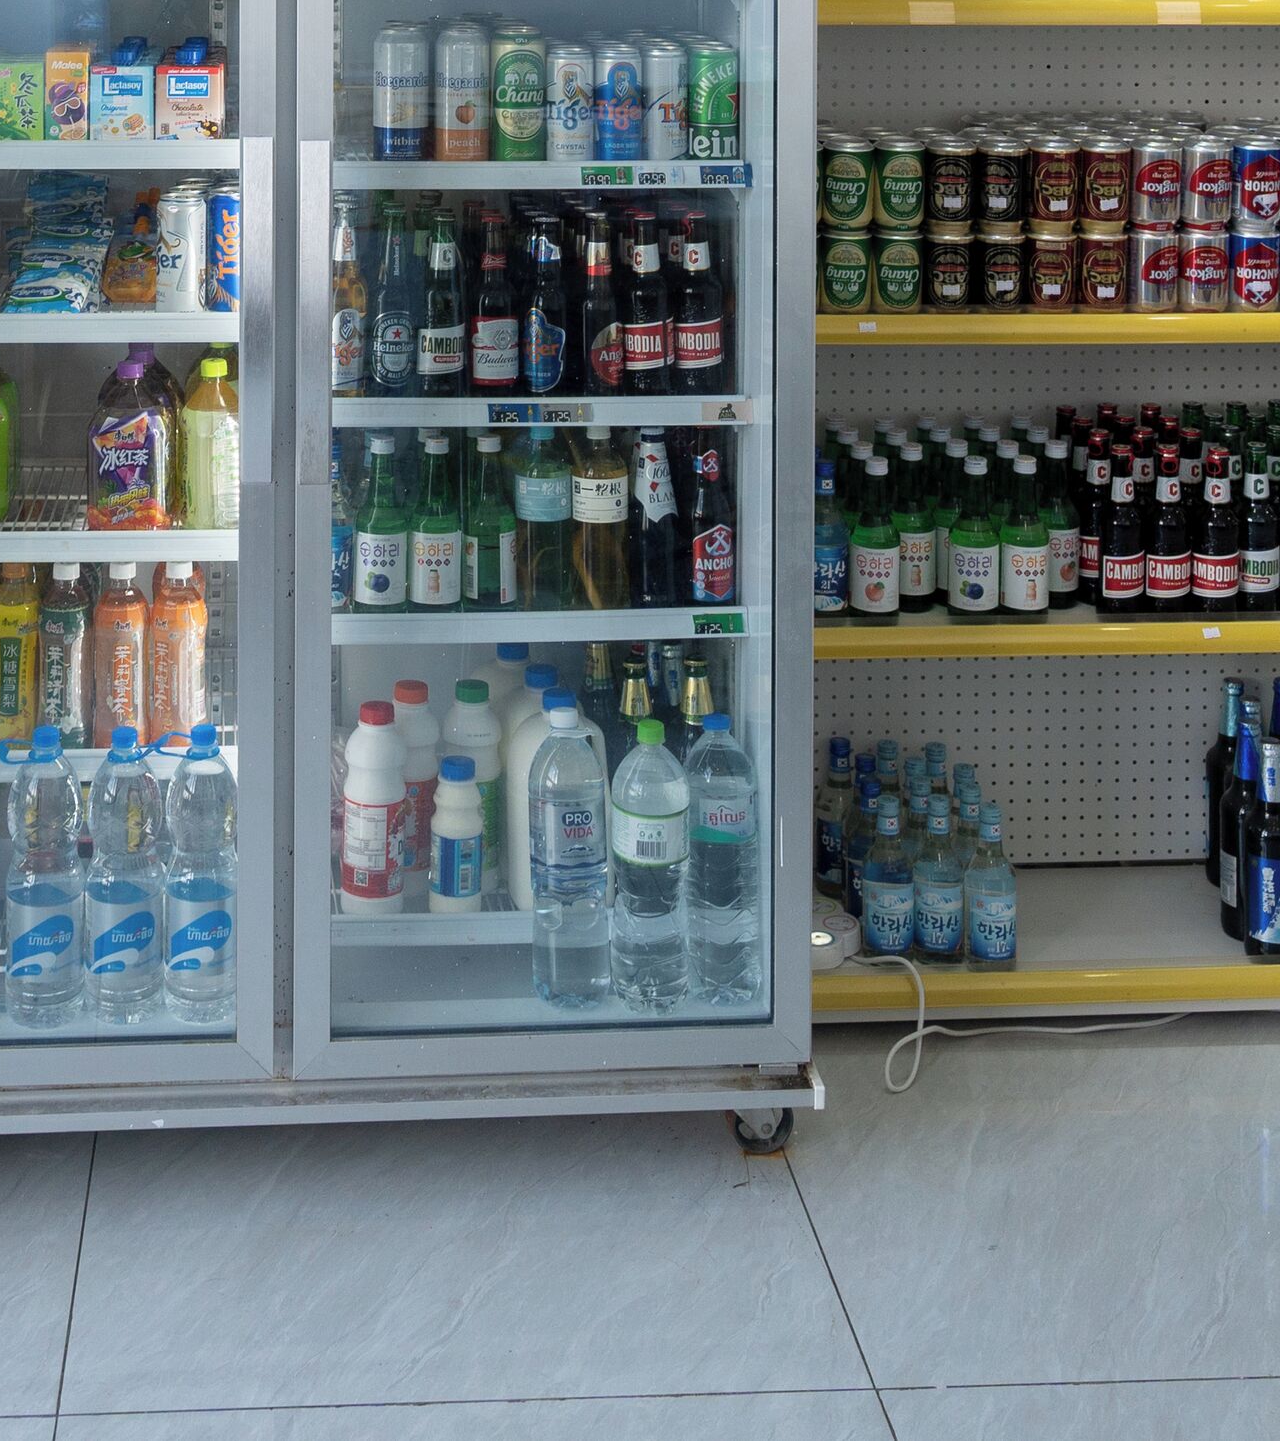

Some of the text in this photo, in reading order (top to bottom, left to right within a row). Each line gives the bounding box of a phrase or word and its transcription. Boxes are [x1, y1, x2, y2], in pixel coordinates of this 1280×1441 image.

[51, 60, 83, 70] Malee
[104, 74, 141, 95] Lactasoy
[169, 75, 208, 96] Lactasoy
[14, 72, 39, 129] 冬瓜茶
[494, 85, 545, 107] Chang
[171, 103, 205, 113] Chocolate
[547, 101, 594, 132] Tiger
[595, 100, 642, 132] Tiger
[386, 135, 421, 147] witbier
[449, 135, 481, 149] peach
[555, 142, 587, 151] CRYSTAL
[826, 178, 866, 194] Chang
[933, 180, 968, 196] ABC
[1039, 181, 1074, 198] ABC
[1185, 267, 1226, 284] Angkor
[1236, 266, 1279, 280] ANCHOR
[99, 446, 150, 475] 冰红茶
[359, 540, 402, 558] 순하리
[414, 540, 455, 558] 순하리
[855, 554, 895, 571] 순하리
[955, 552, 994, 571] 순하리
[1, 642, 19, 709] 冰糖雪梨
[45, 645, 68, 724] 茉莉清茶
[112, 645, 134, 722] 茉莉蜜茶
[564, 812, 593, 827] PRO
[563, 825, 595, 841] VIDA
[871, 913, 914, 936] 한라산
[917, 912, 959, 934] 한라산
